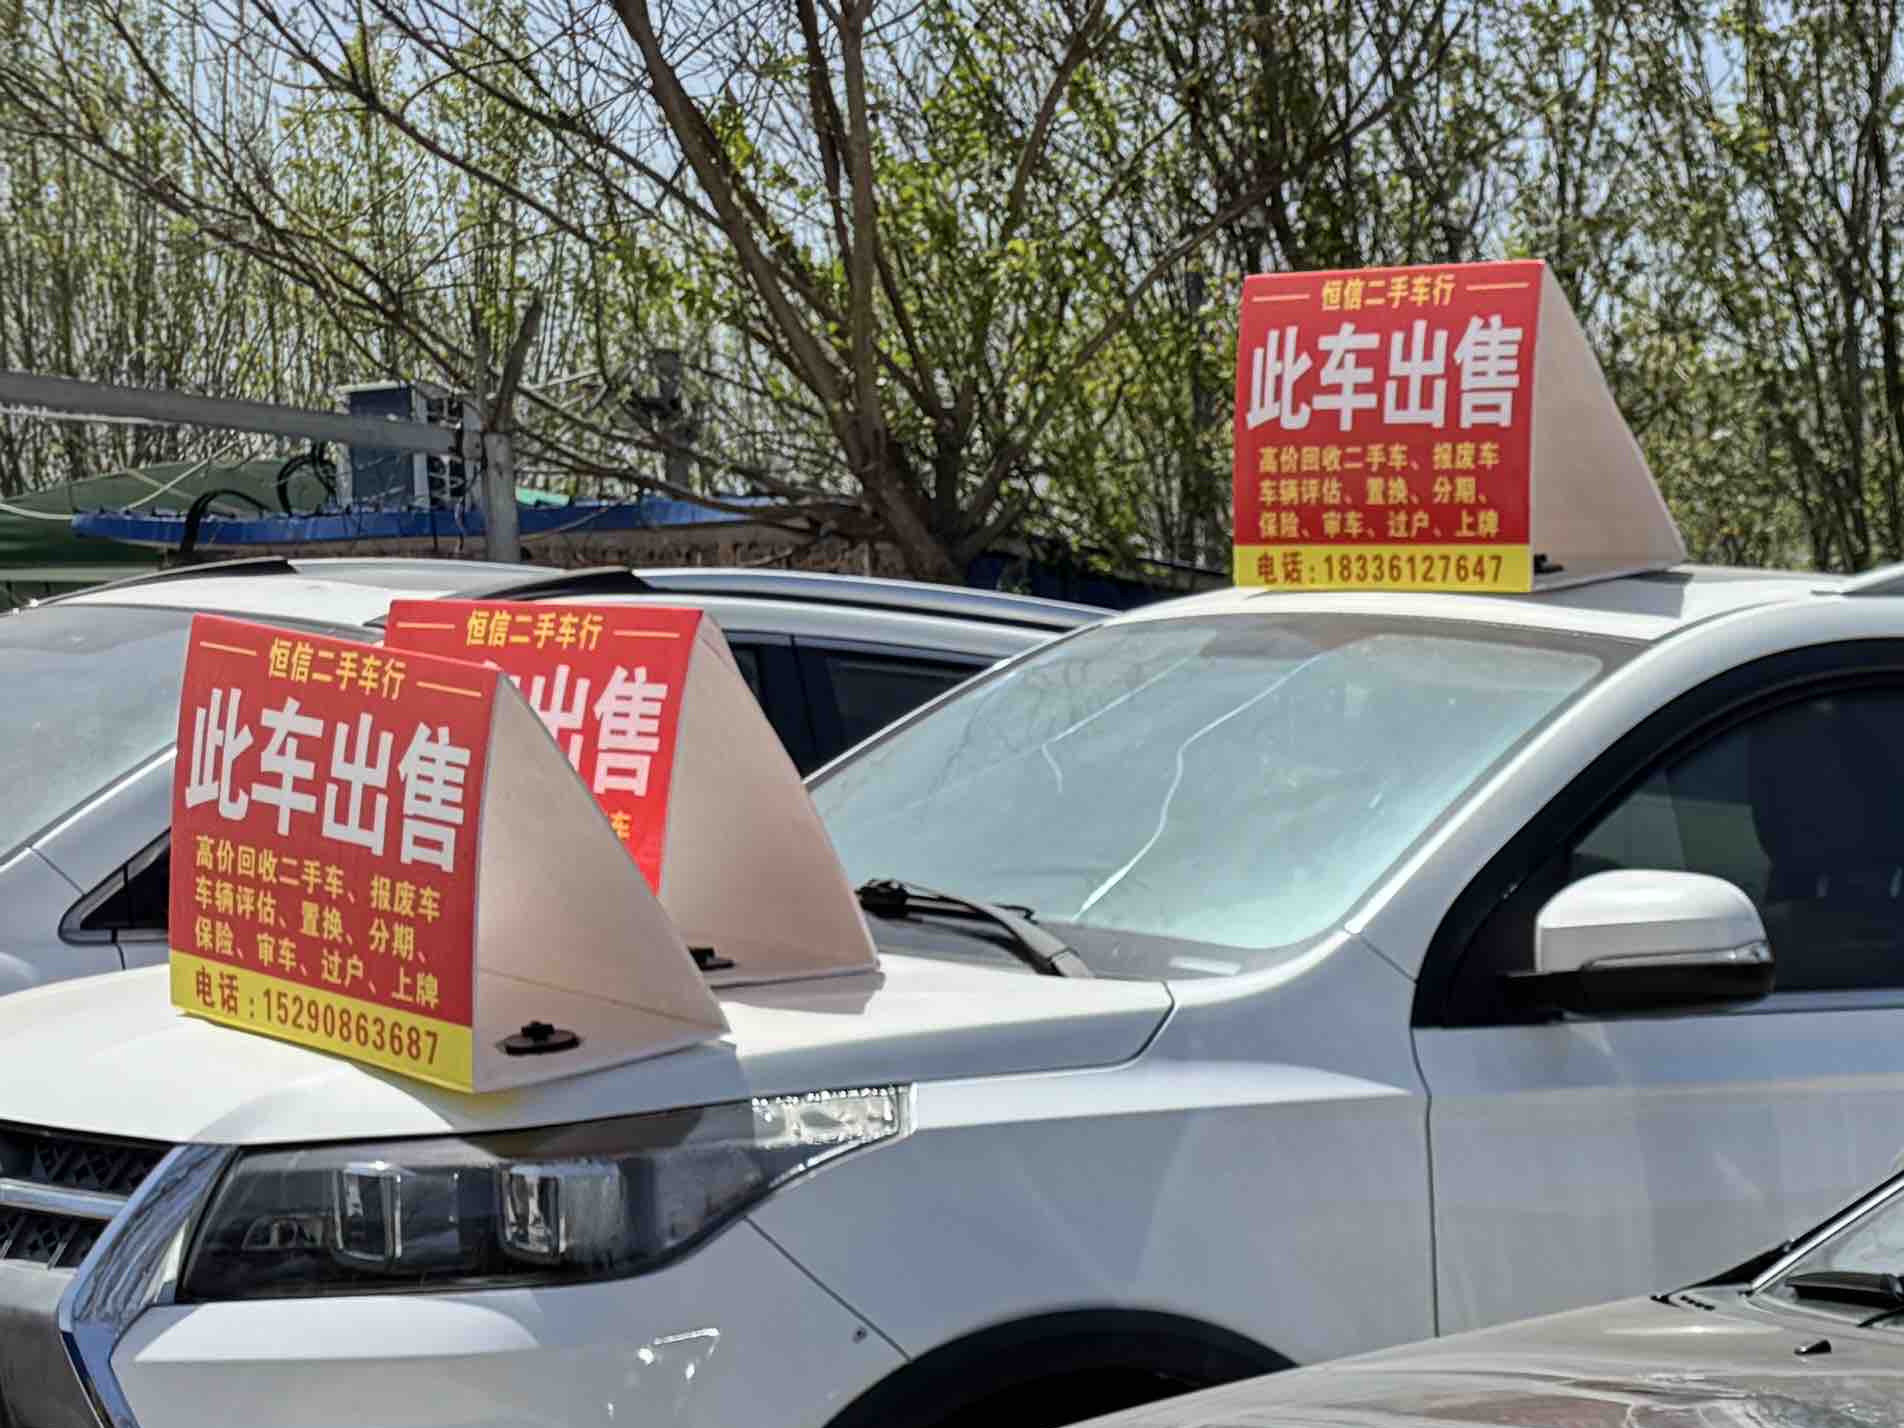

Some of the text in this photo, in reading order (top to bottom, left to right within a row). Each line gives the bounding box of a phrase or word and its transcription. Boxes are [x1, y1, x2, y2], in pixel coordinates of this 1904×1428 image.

[1321, 273, 1457, 312] 恒信二手车行
[1246, 315, 1524, 433] 此车出售
[268, 637, 407, 701] 恒信二手车行
[465, 609, 604, 651] 恒信二手车行
[509, 663, 669, 798] 出售
[184, 686, 472, 873] 此车出售
[194, 834, 441, 924] 高价回收二手车、报废车
[194, 875, 428, 963] 车辆评估、置换、分期、
[194, 915, 440, 1010] 保险、审车、过户、上牌
